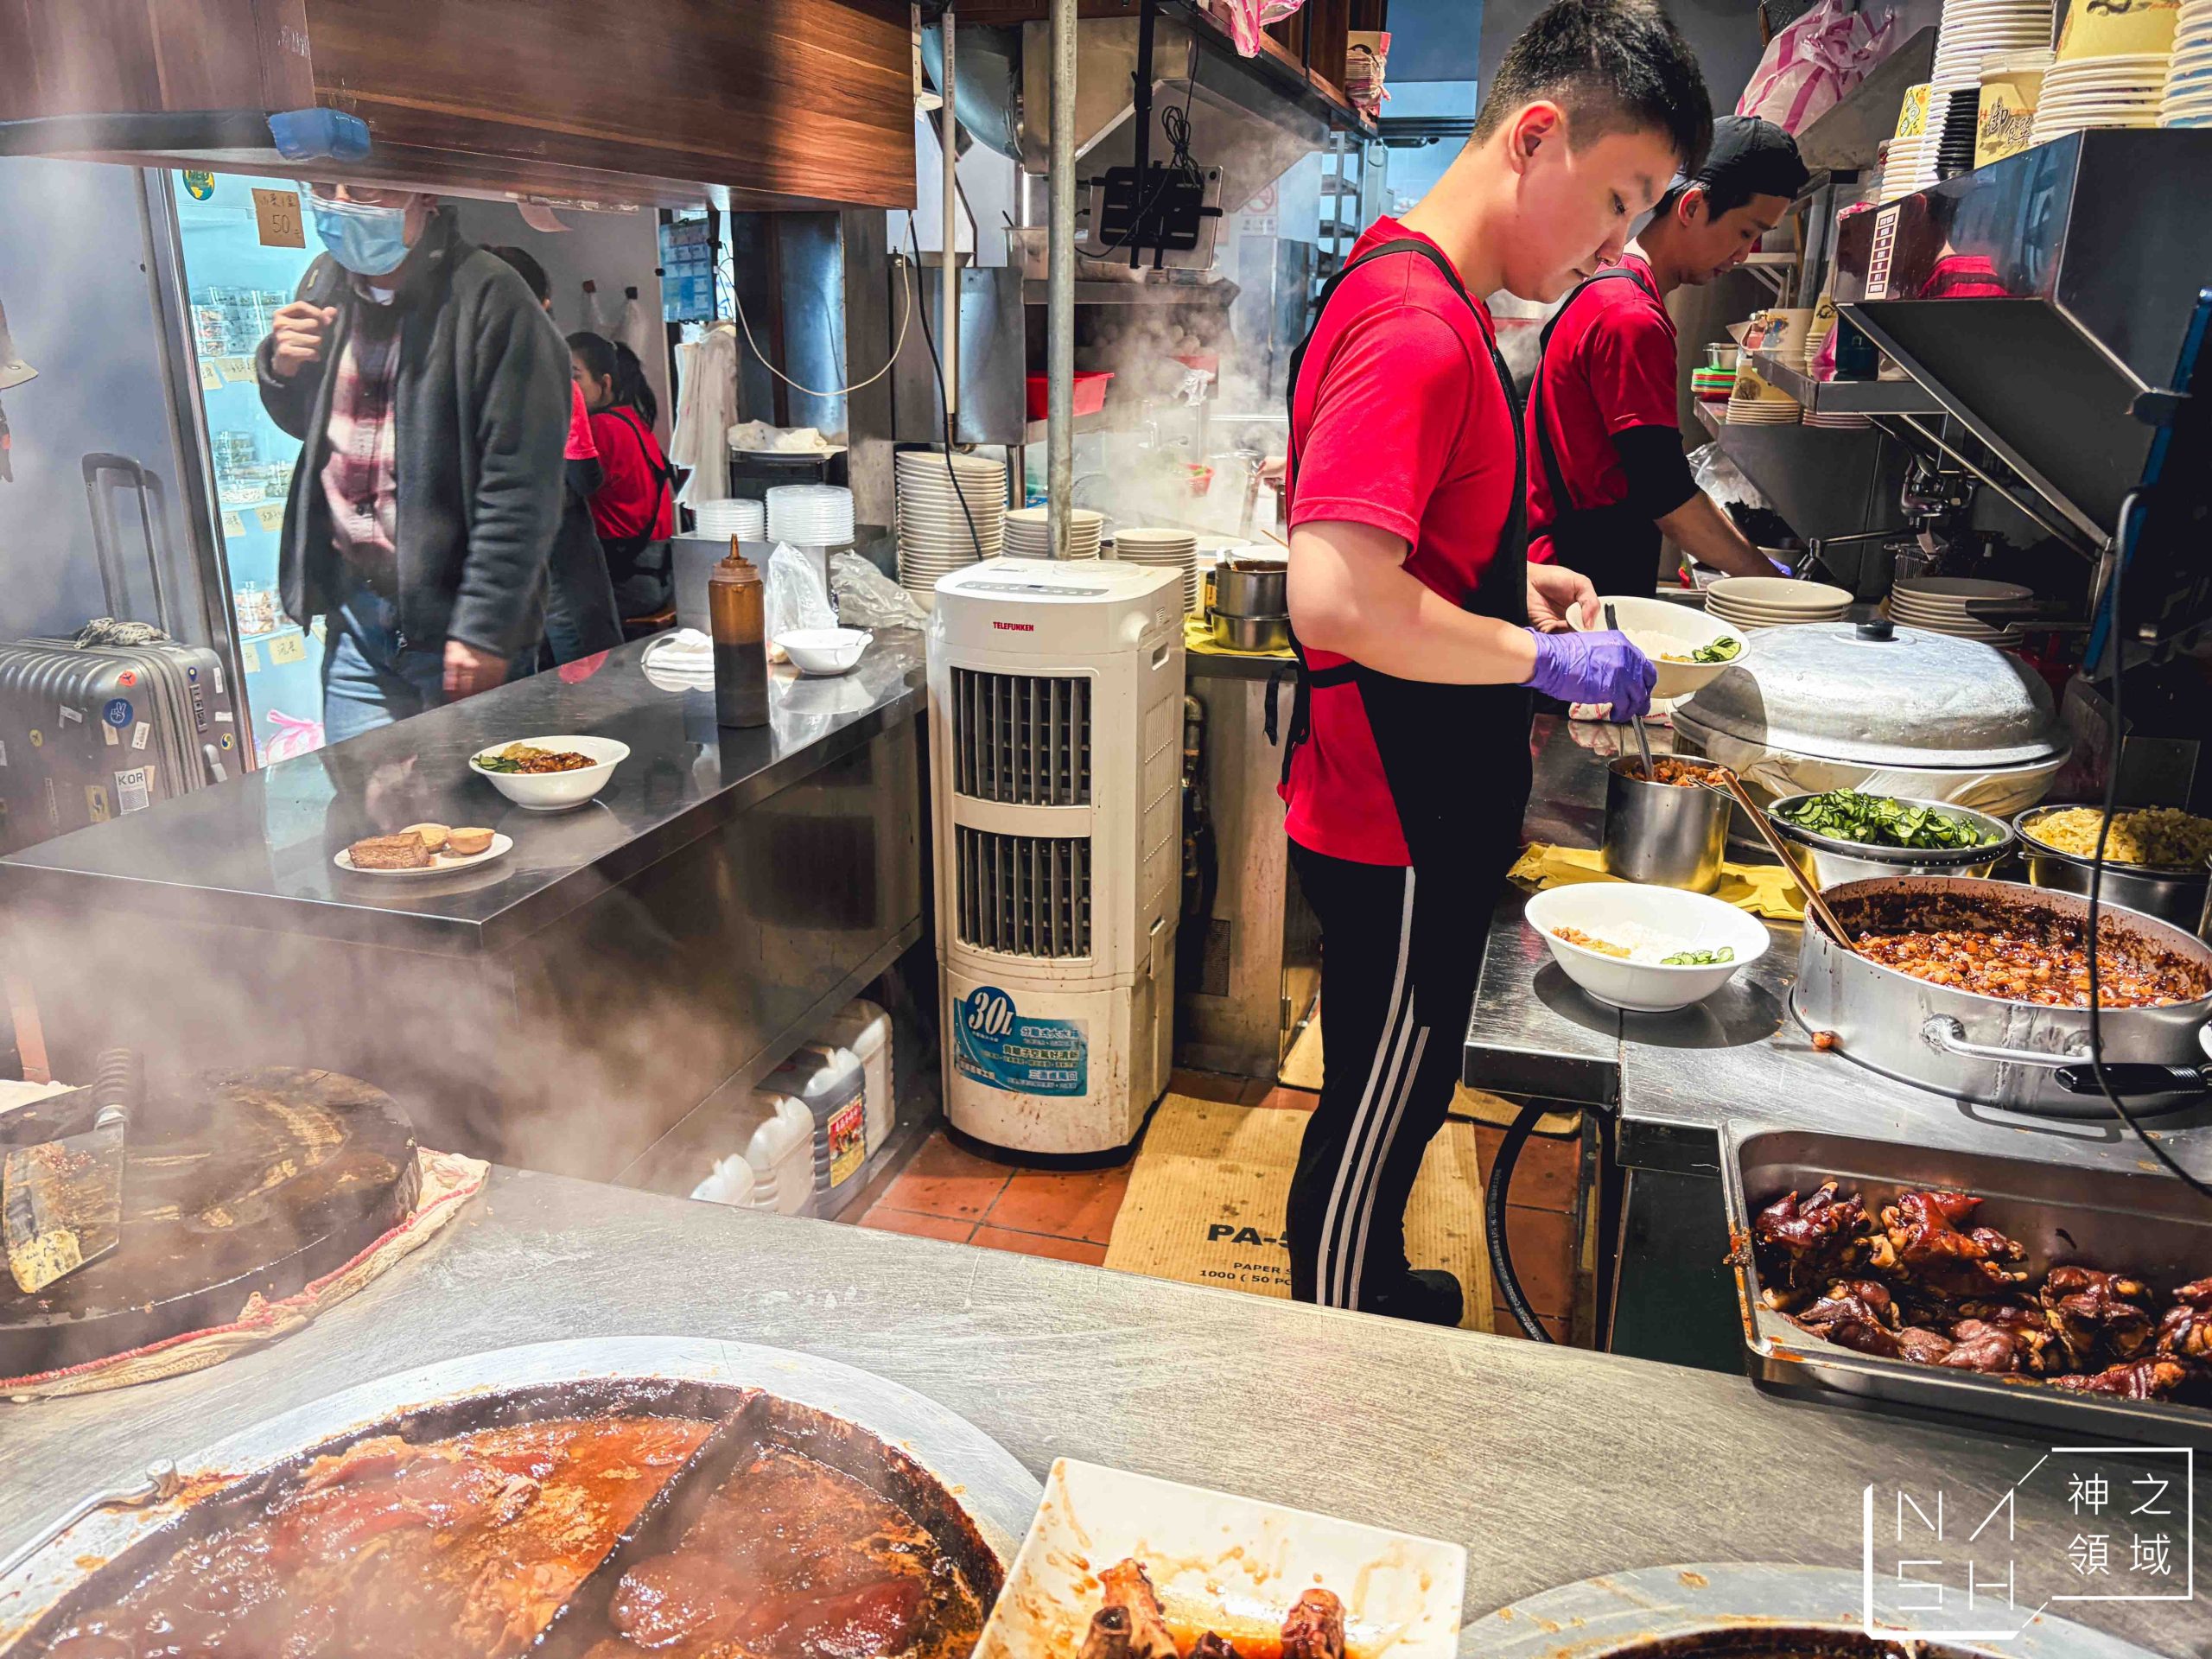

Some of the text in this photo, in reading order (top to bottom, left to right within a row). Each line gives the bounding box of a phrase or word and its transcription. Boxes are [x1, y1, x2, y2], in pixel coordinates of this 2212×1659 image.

[271, 214, 290, 233] 50
[993, 621, 1034, 632] TELEFUNKEN
[118, 772, 143, 785] KOR
[968, 992, 1014, 1035] 30L
[1234, 1262, 1281, 1274] PAPER
[1199, 1270, 1236, 1280] 1000
